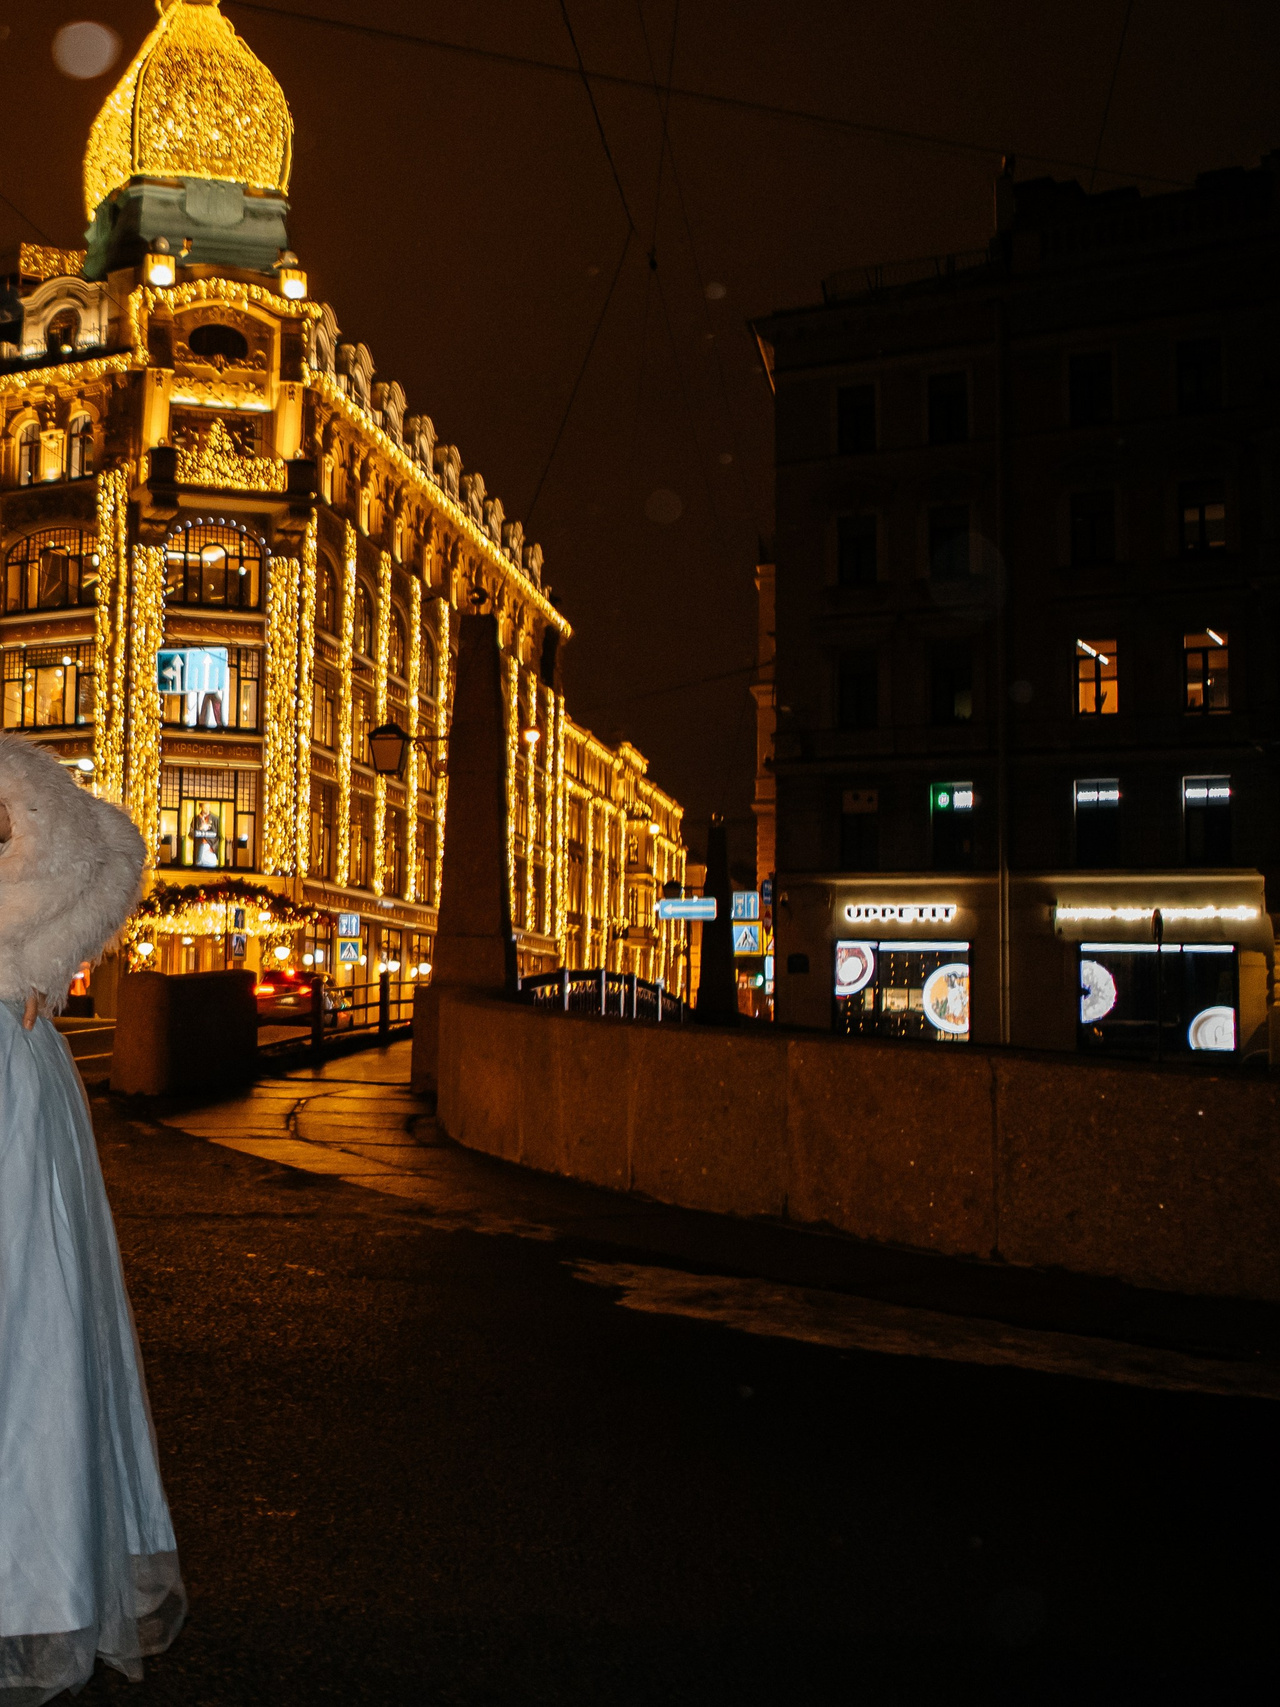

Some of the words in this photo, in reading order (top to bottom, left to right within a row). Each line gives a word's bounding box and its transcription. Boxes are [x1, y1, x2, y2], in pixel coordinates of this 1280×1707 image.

[223, 624, 261, 636] ROUGE
[173, 743, 224, 755] КРАСНАГО
[229, 746, 260, 757] МОСТА
